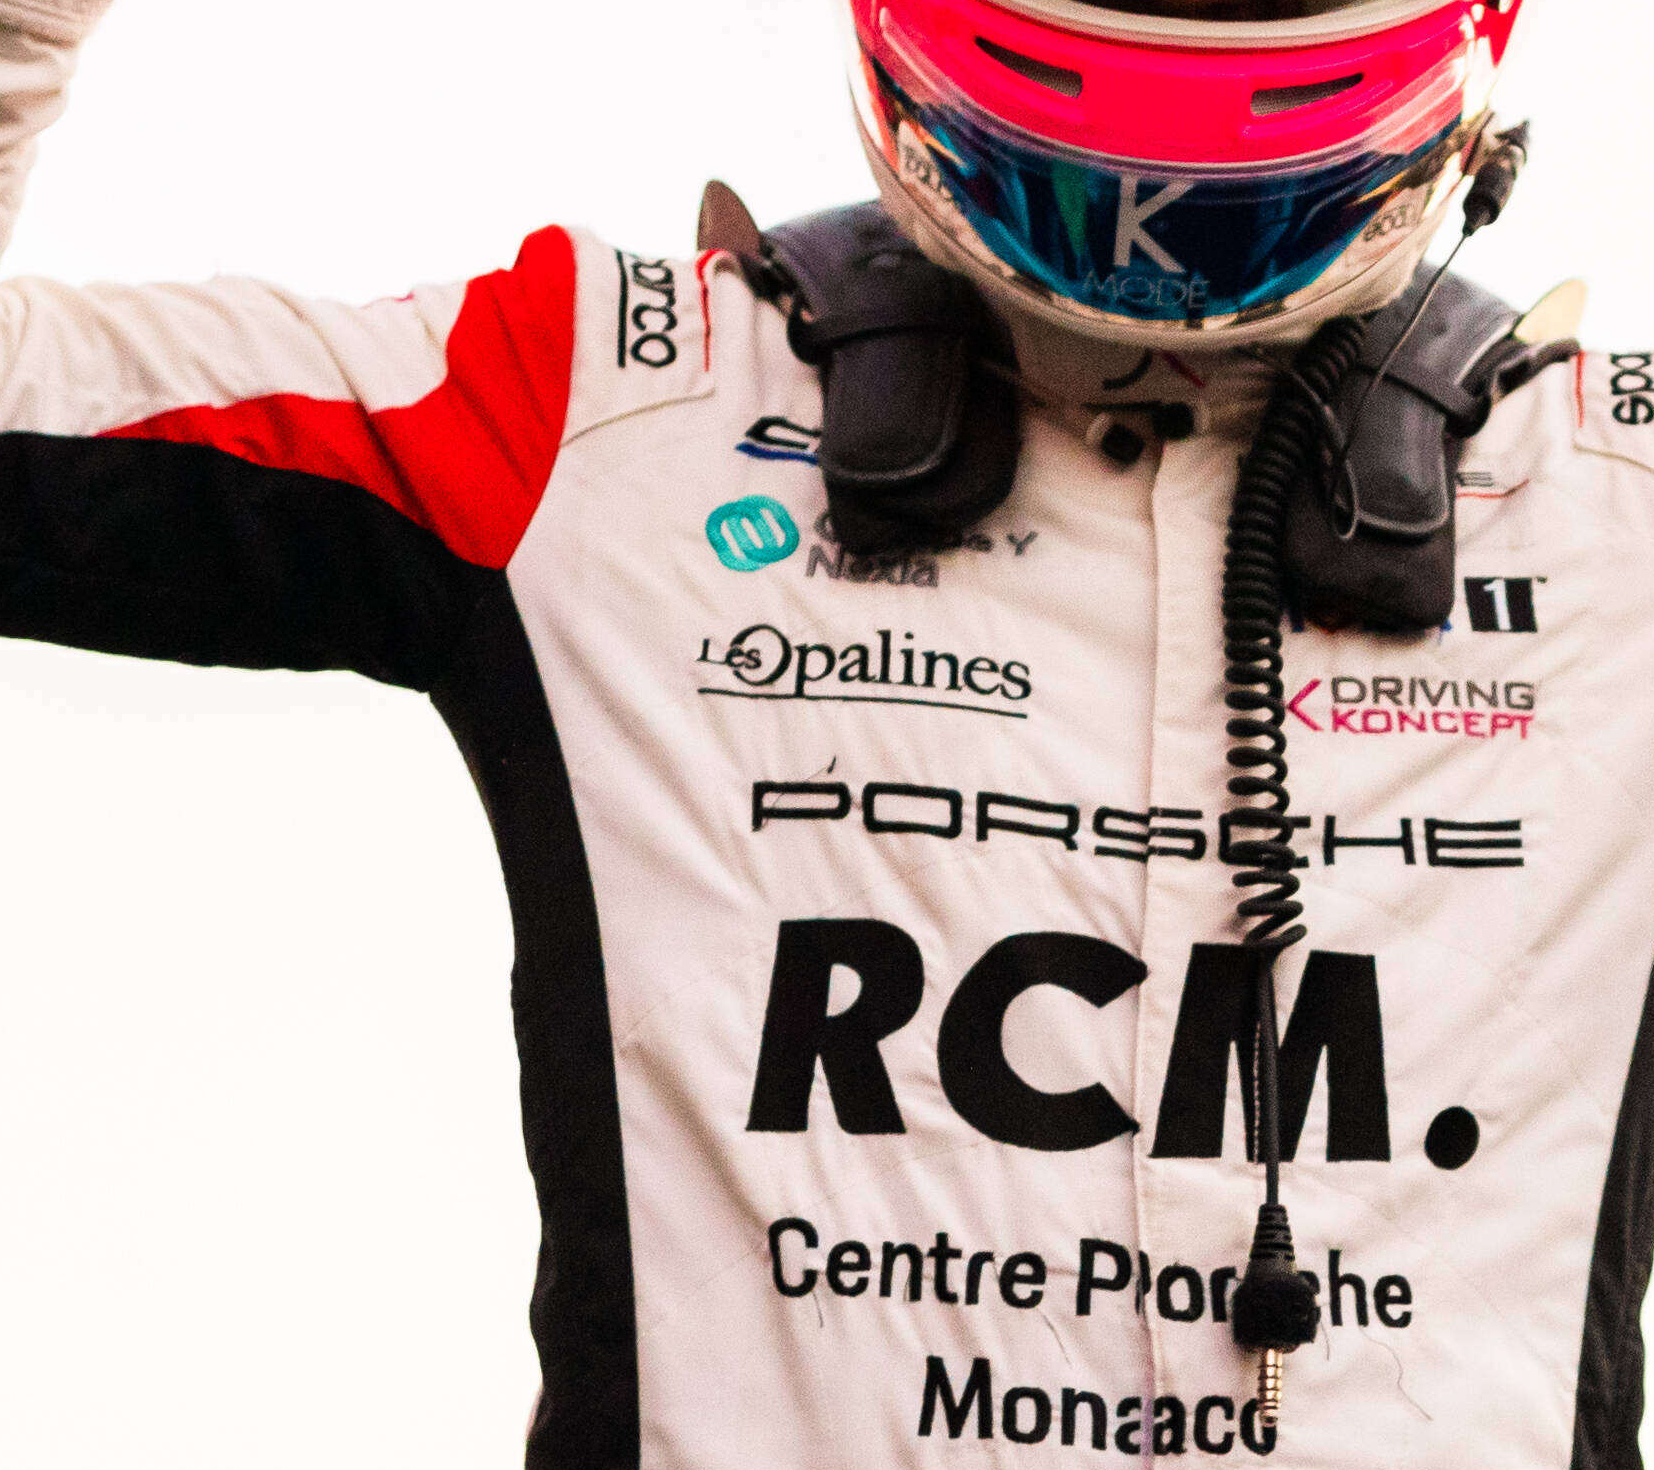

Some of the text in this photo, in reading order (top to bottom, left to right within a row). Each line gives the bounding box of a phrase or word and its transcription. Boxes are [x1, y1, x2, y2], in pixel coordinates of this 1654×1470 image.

[1113, 172, 1193, 273] K
[1083, 269, 1210, 309] MODE
[730, 623, 1033, 701] Opalines
[1330, 676, 1536, 712] DRIVING
[1331, 708, 1536, 740] KONCEPT
[751, 779, 1526, 868] PORSCHE
[744, 916, 1481, 1171] RCM.
[767, 1216, 1414, 1330] Centre Porhe
